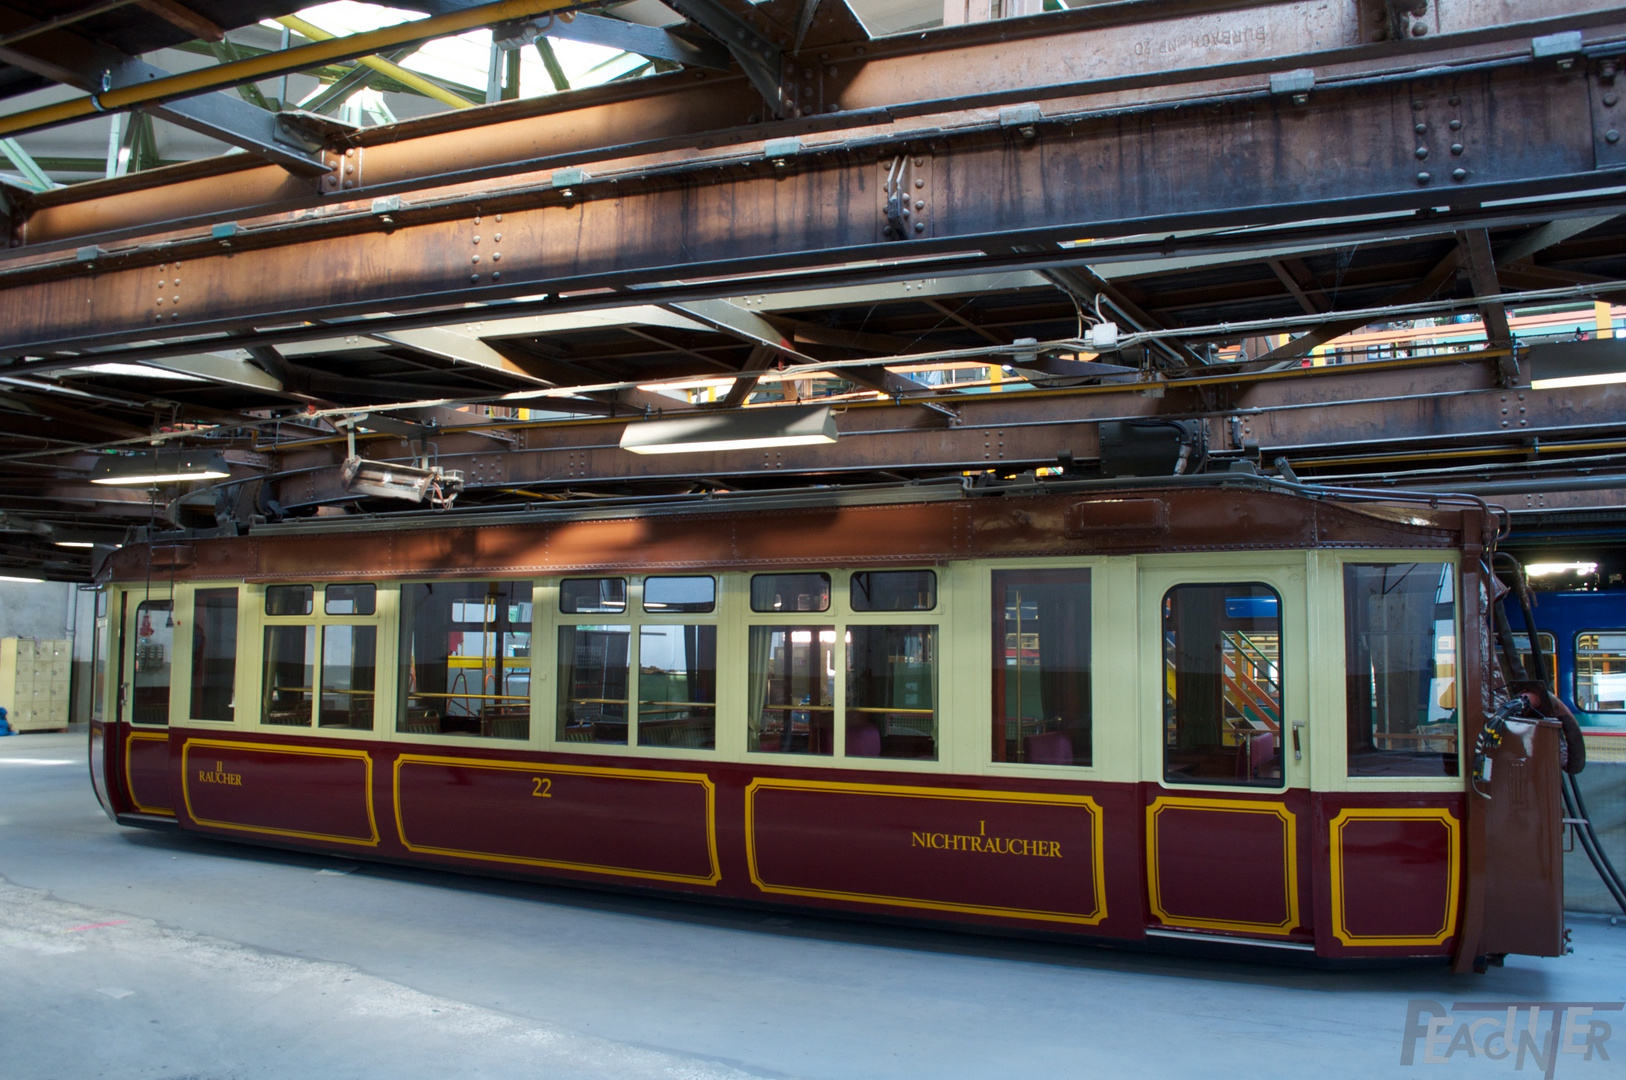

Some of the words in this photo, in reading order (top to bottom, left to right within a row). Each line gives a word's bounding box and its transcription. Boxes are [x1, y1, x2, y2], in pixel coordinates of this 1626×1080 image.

[216, 760, 223, 772] II
[198, 770, 242, 786] RAUCHER
[532, 777, 552, 798] 22
[979, 820, 986, 836] I
[911, 831, 1063, 858] NICHTRAUCHER
